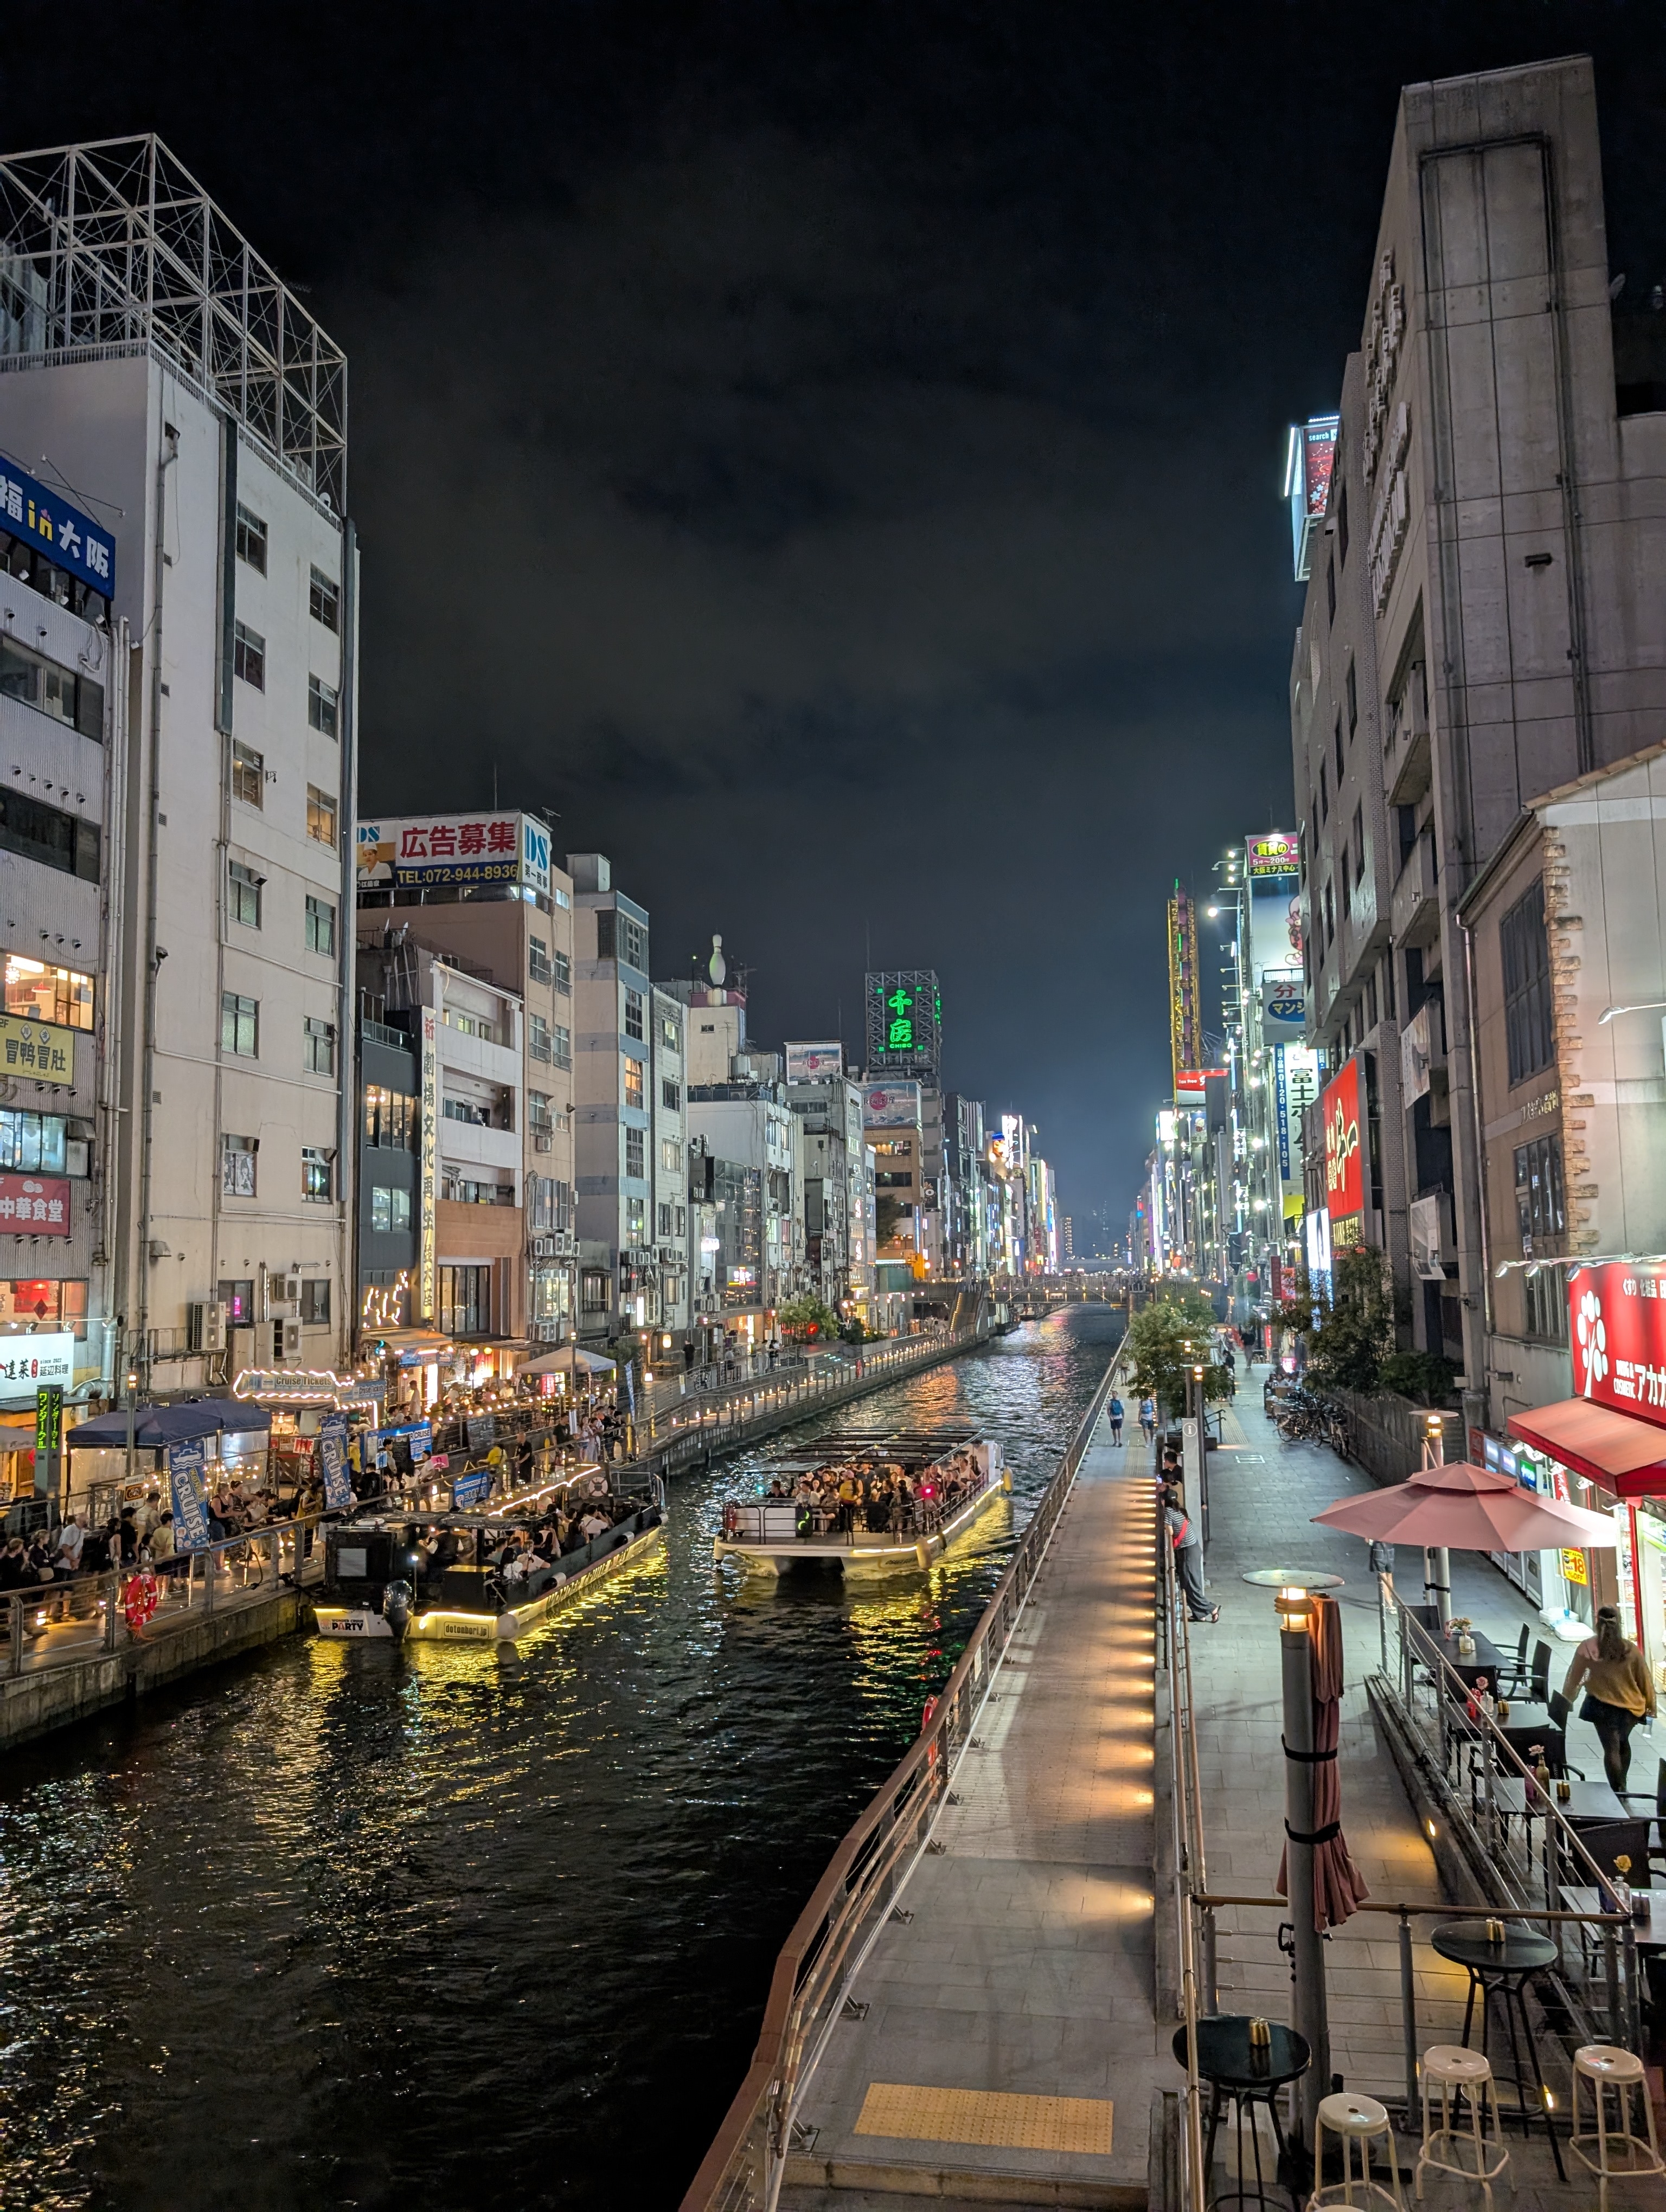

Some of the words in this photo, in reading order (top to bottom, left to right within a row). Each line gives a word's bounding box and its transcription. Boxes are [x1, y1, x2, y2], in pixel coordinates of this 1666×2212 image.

[1309, 432, 1329, 441] search
[357, 826, 380, 843] DS
[400, 821, 516, 858] 広告募集
[525, 824, 548, 871] DS
[1257, 841, 1287, 856] 賃貸の
[397, 865, 517, 884] TEL:072-944-8936
[888, 989, 912, 1042] 千房
[0, 1196, 63, 1222] 中華食堂
[1623, 1278, 1637, 1296] くすり
[1640, 1278, 1658, 1298] 化粧品
[40, 1364, 68, 1377] 延辺料理
[1616, 1359, 1629, 1378] DRUG
[1629, 1362, 1635, 1379] &
[276, 1375, 301, 1386] Cruise
[303, 1375, 332, 1386] Tickets
[1613, 1378, 1636, 1399] COSMETIC
[414, 1429, 430, 1439] CRUISE
[322, 1438, 348, 1498] CRUISE
[189, 1467, 206, 1504] WONDER
[173, 1470, 207, 1541] CRUISE
[1570, 1557, 1585, 1574] 18
[332, 1622, 364, 1631] PARTY
